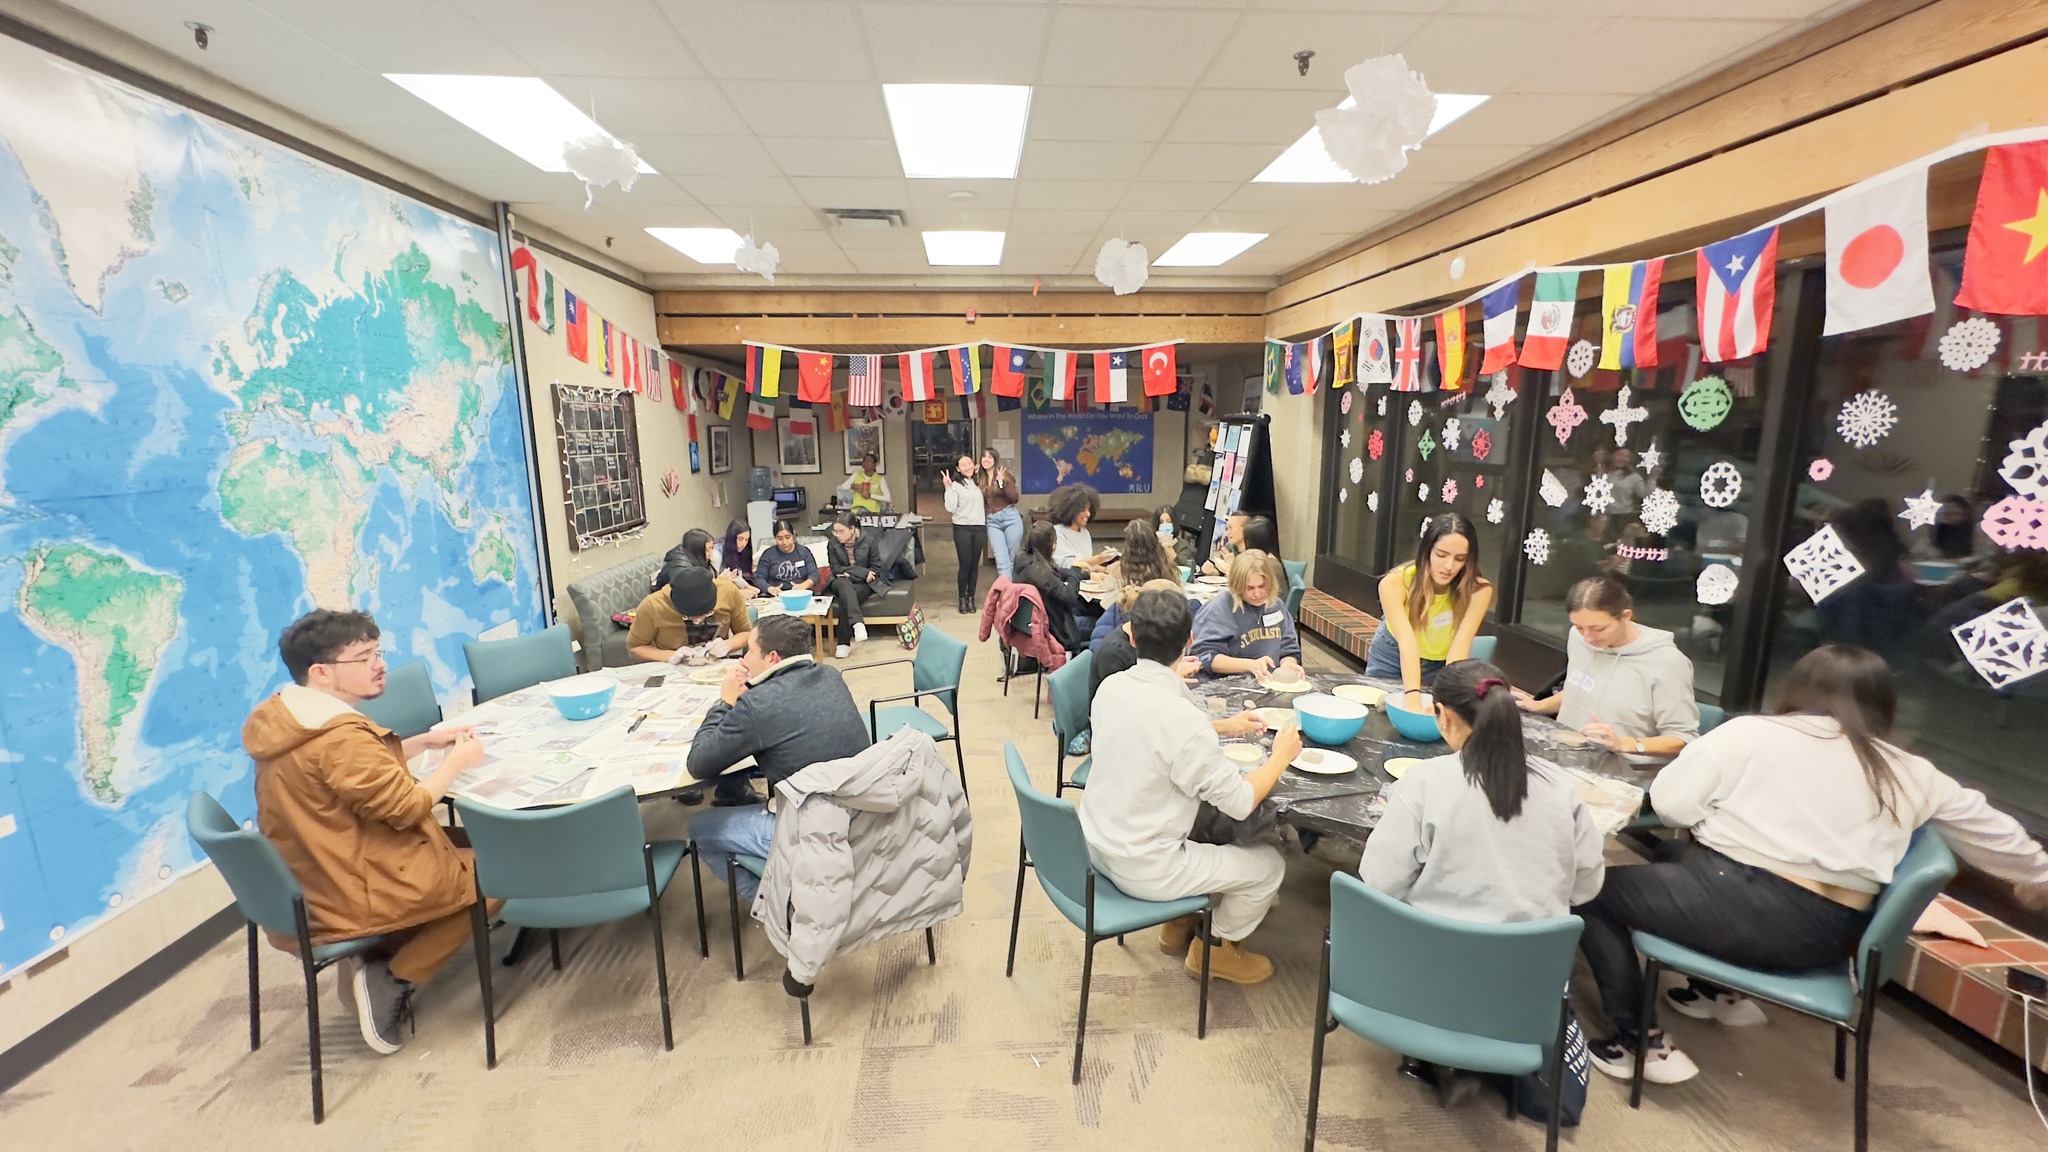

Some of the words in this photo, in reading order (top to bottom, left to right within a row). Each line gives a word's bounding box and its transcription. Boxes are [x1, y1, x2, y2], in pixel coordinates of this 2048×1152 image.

[1027, 413, 1049, 421] Where
[1109, 412, 1126, 420] Want
[1128, 483, 1152, 493] MRU
